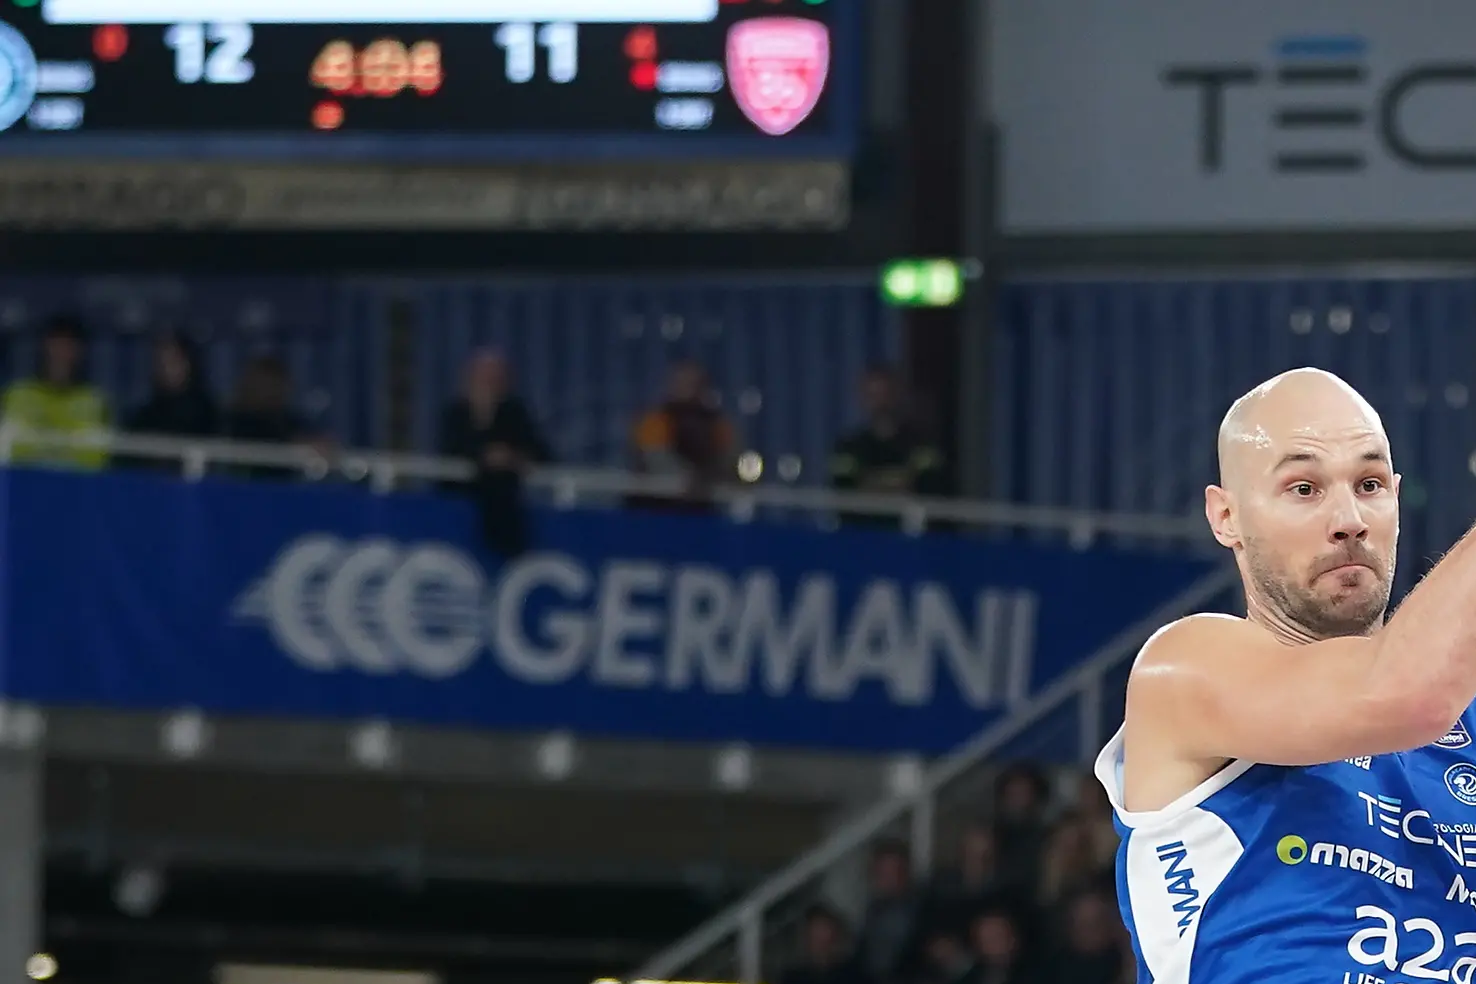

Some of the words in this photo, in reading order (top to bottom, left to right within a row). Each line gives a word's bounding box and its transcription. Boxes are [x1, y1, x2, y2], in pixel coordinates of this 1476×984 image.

[163, 22, 255, 83] 12
[494, 22, 579, 83] 11
[494, 551, 1038, 711] GERMANI
[1156, 840, 1201, 939] MANI
